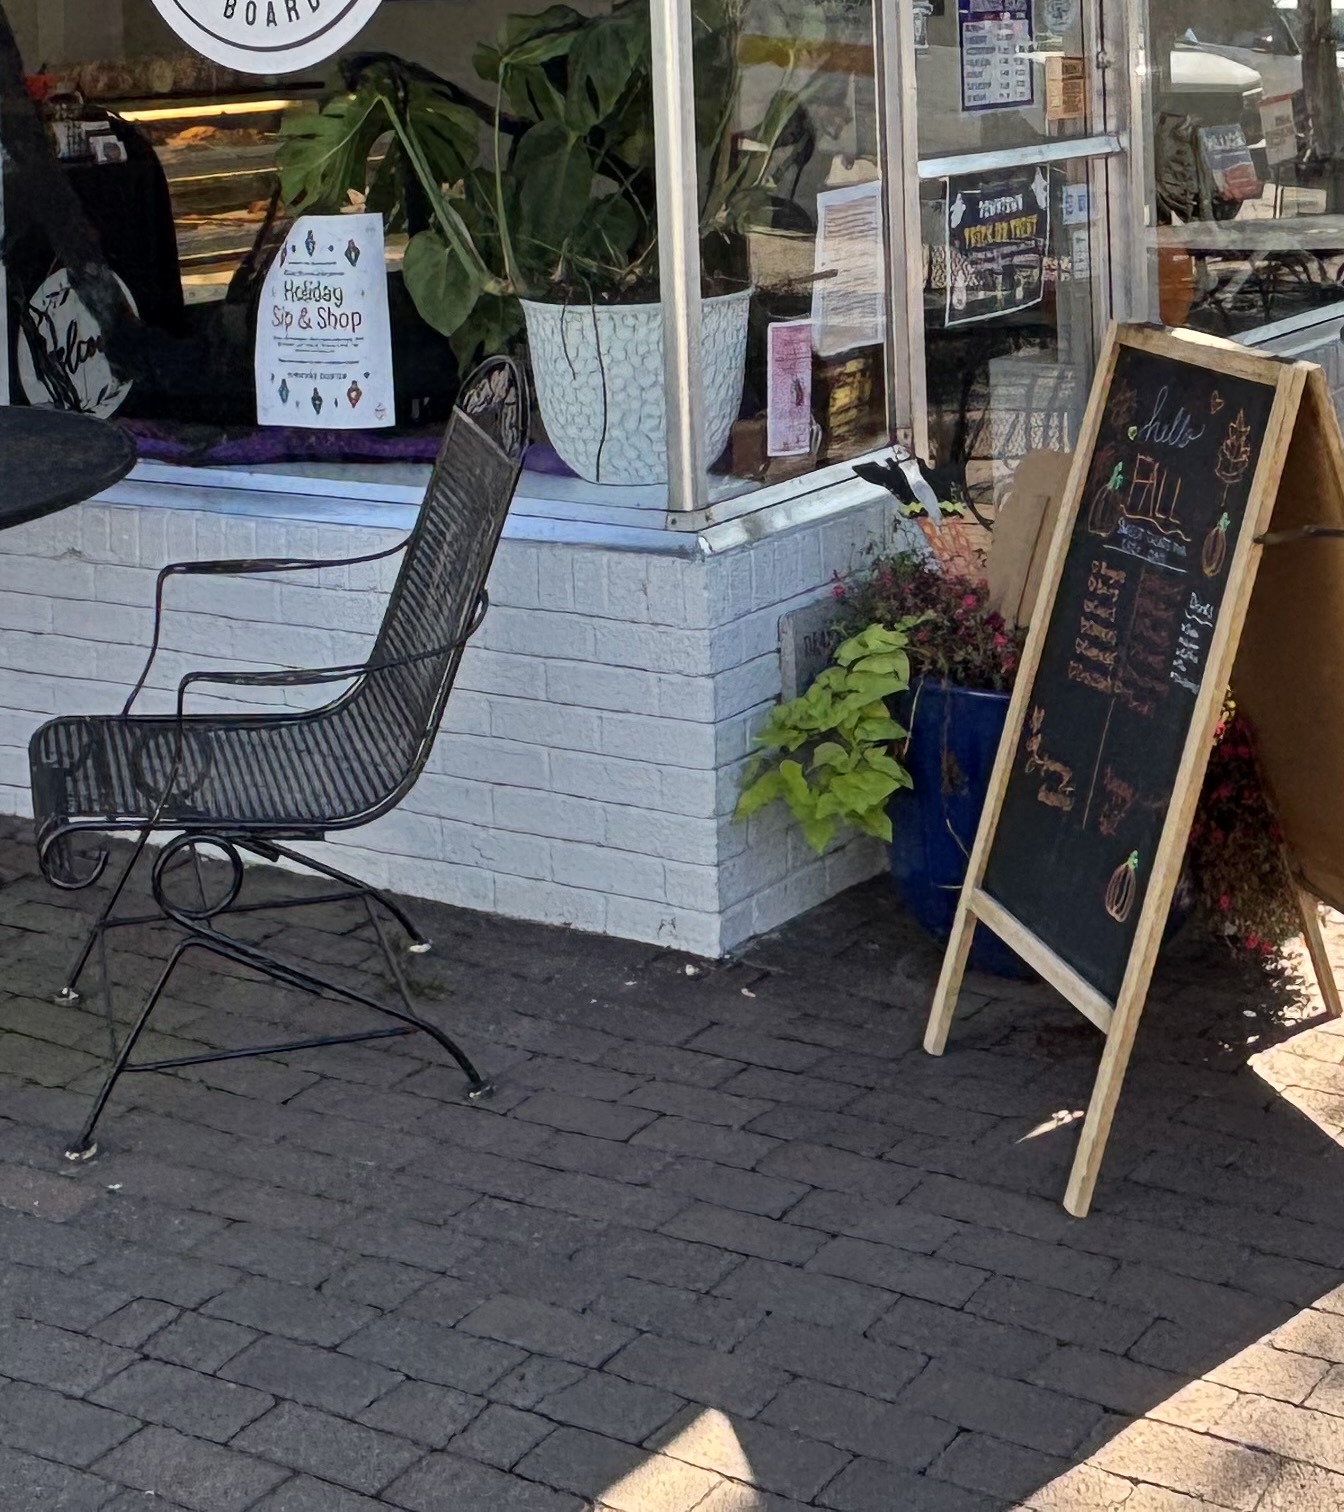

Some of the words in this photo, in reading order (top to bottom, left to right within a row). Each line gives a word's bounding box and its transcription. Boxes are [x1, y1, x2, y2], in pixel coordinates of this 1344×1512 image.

[283, 279, 343, 307] Holiday
[272, 305, 293, 332] Sip
[298, 306, 313, 330] &
[317, 306, 362, 333] Shop
[1137, 385, 1206, 449] hello
